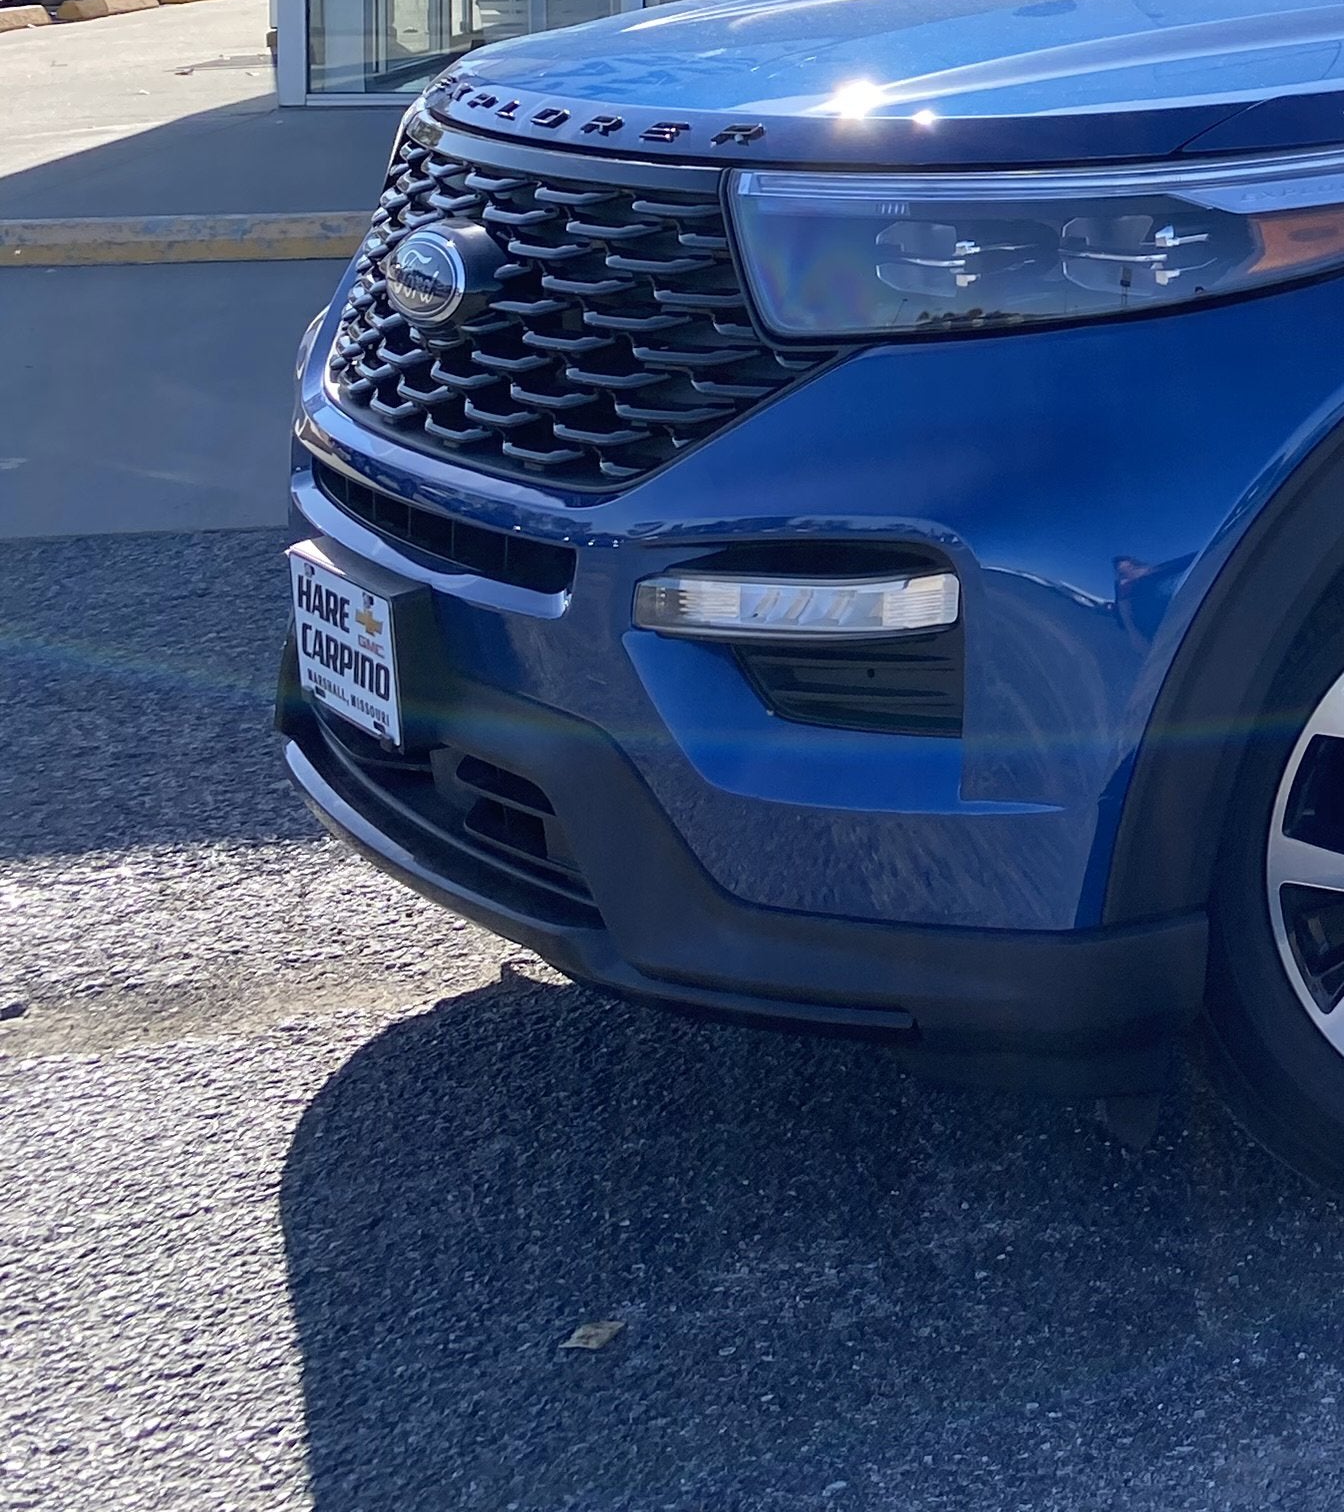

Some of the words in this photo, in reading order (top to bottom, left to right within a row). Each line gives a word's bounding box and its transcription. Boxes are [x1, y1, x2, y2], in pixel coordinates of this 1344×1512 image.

[298, 575, 350, 633] HARE
[302, 623, 390, 702] CARPINO
[358, 635, 385, 658] GMC
[351, 695, 389, 725] MISSOURI
